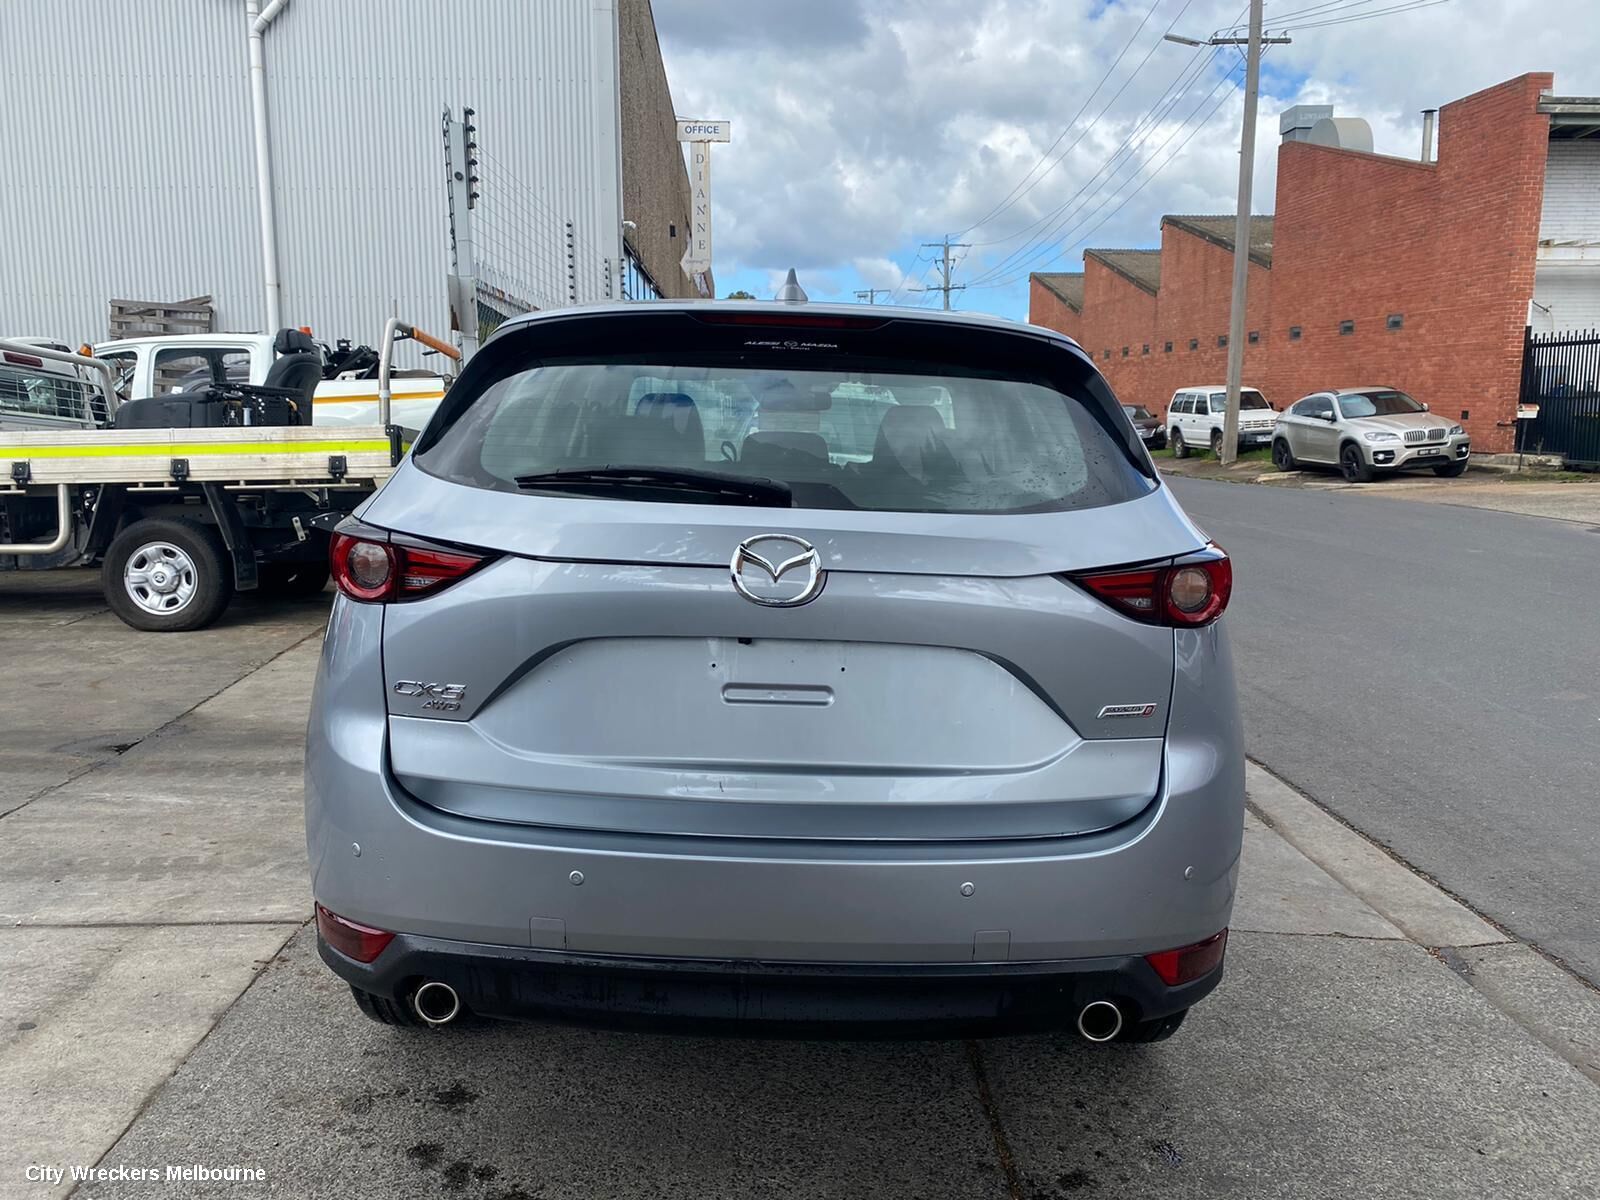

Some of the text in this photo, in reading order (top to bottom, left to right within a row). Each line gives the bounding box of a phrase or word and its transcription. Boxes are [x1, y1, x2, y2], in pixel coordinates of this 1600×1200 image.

[685, 125, 720, 135] OFFICE
[695, 153, 706, 250] DIANNE
[393, 680, 467, 700] CX-5
[421, 700, 461, 711] AWD
